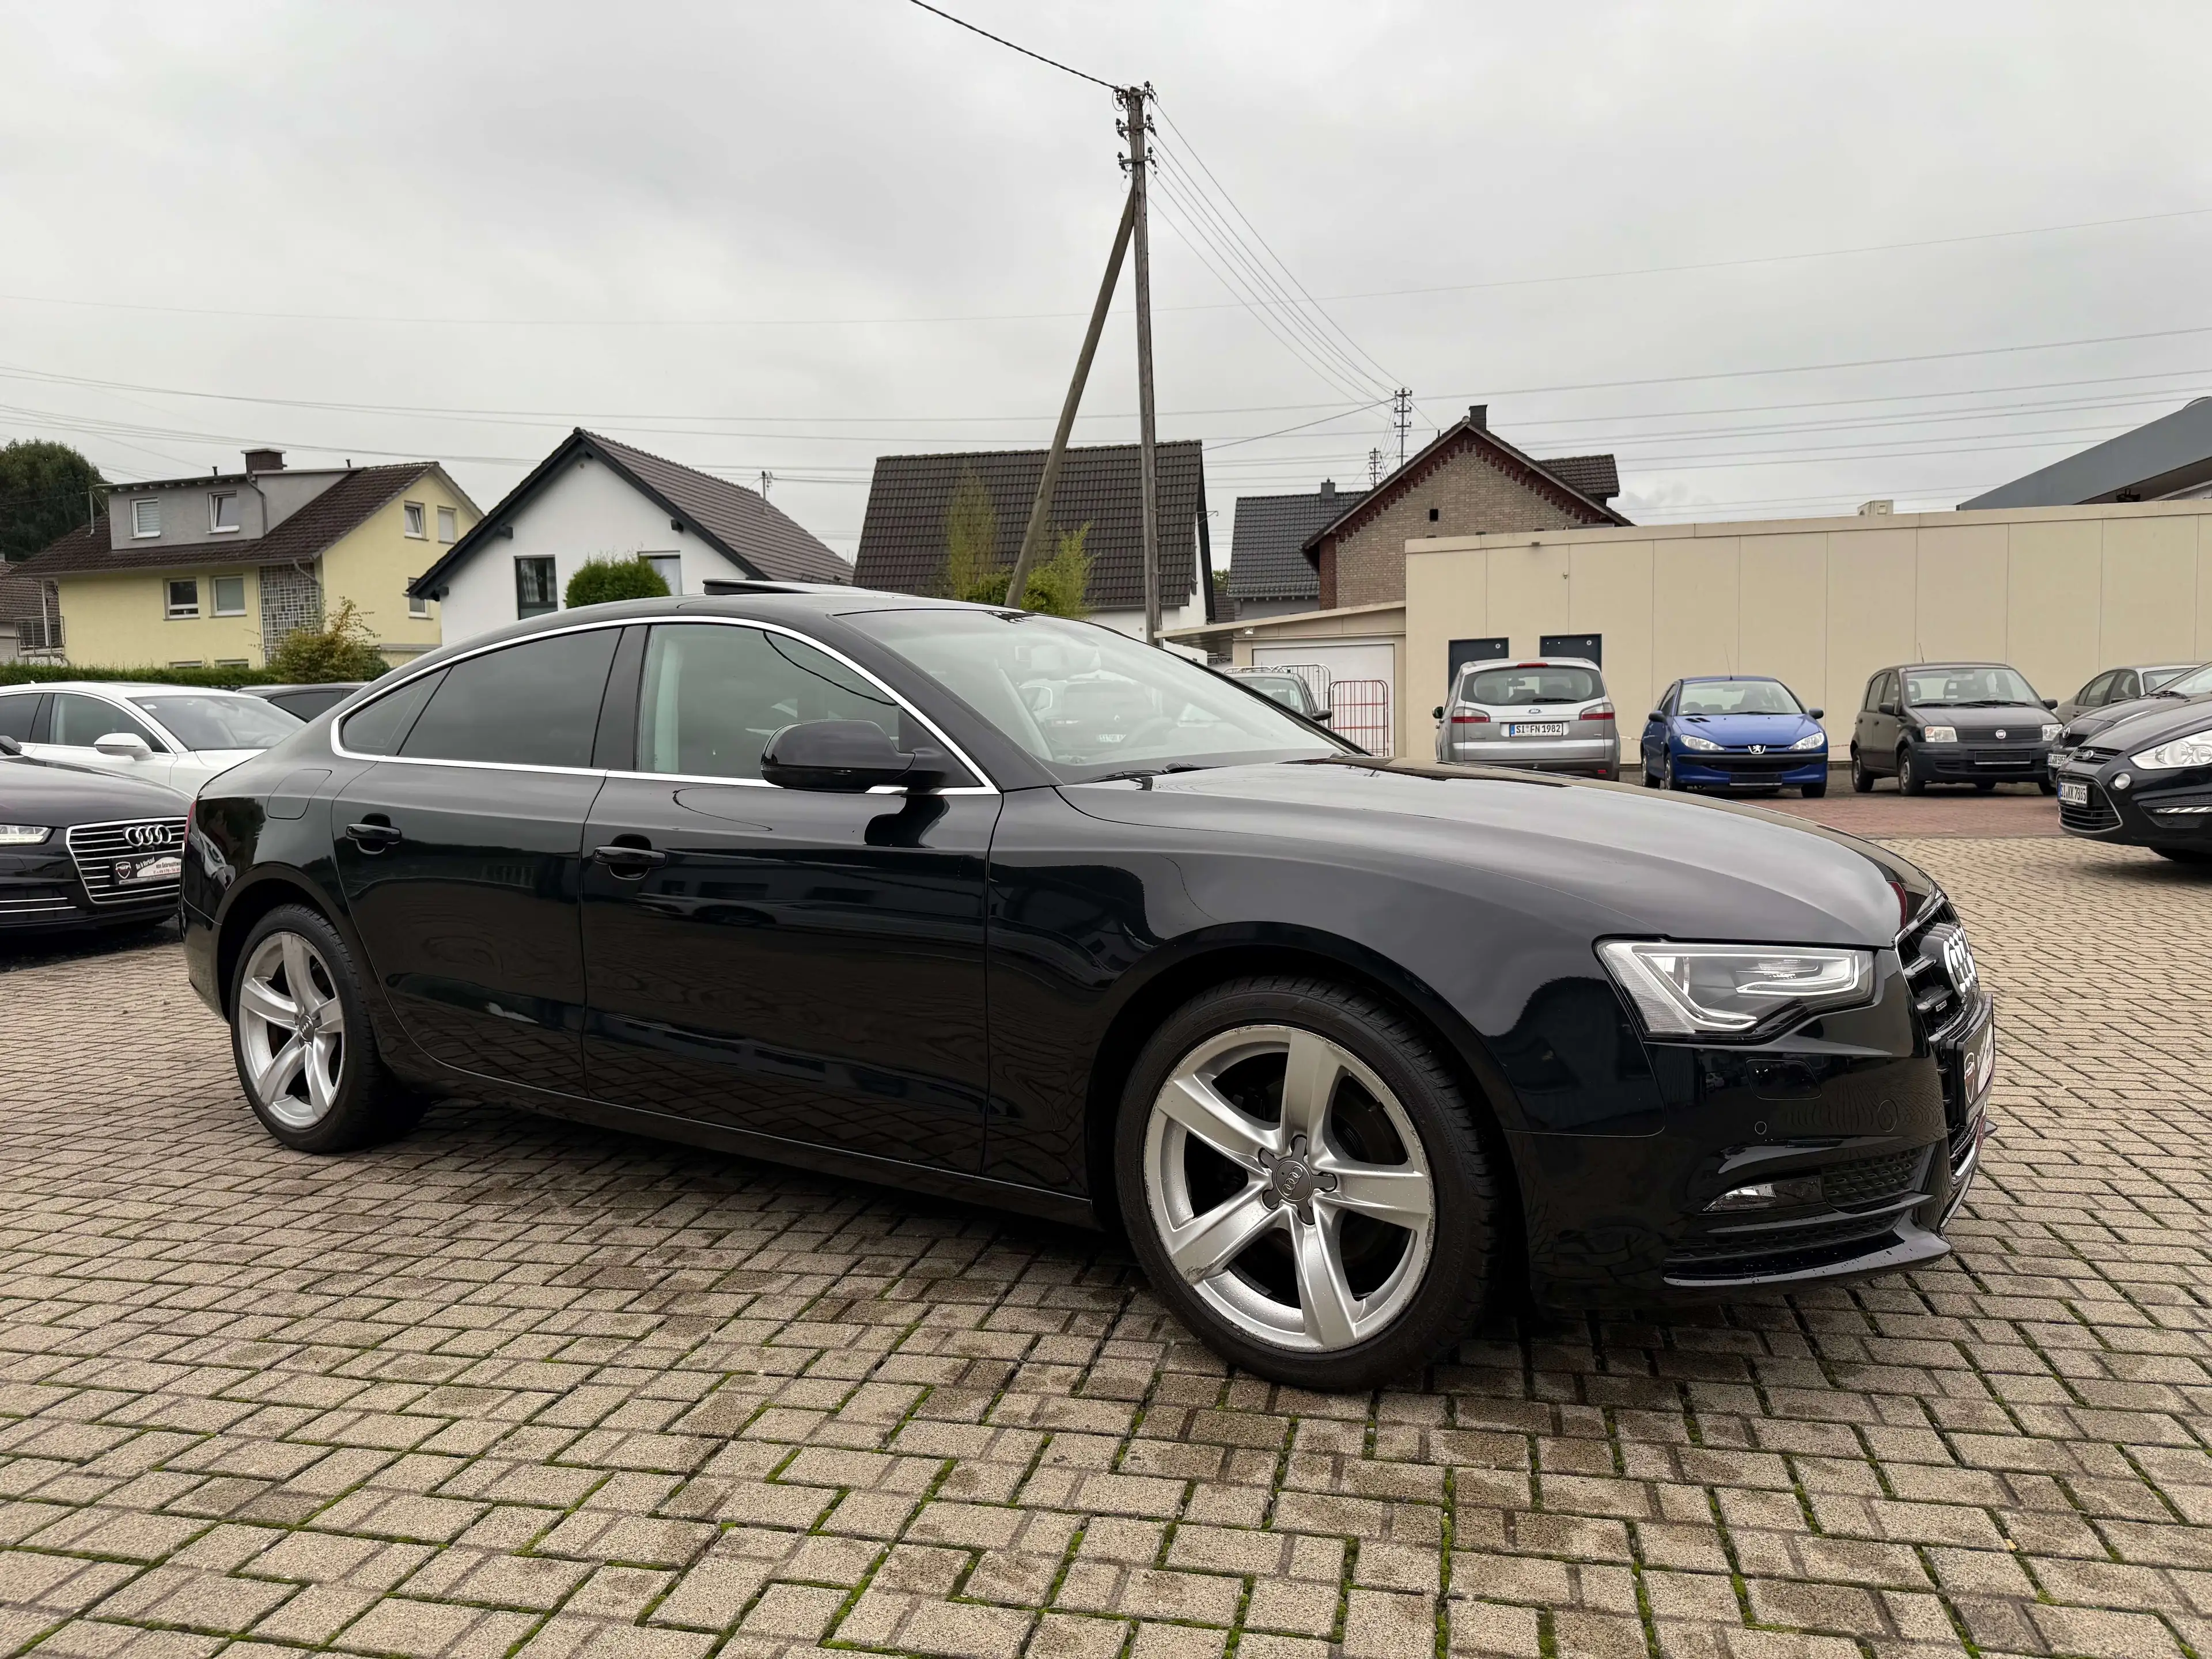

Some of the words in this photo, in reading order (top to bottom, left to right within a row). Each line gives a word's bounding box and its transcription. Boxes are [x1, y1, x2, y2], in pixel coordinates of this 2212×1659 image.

[1516, 725, 1525, 733] SI
[1530, 725, 1540, 733] FN
[1541, 724, 1560, 733] 1982
